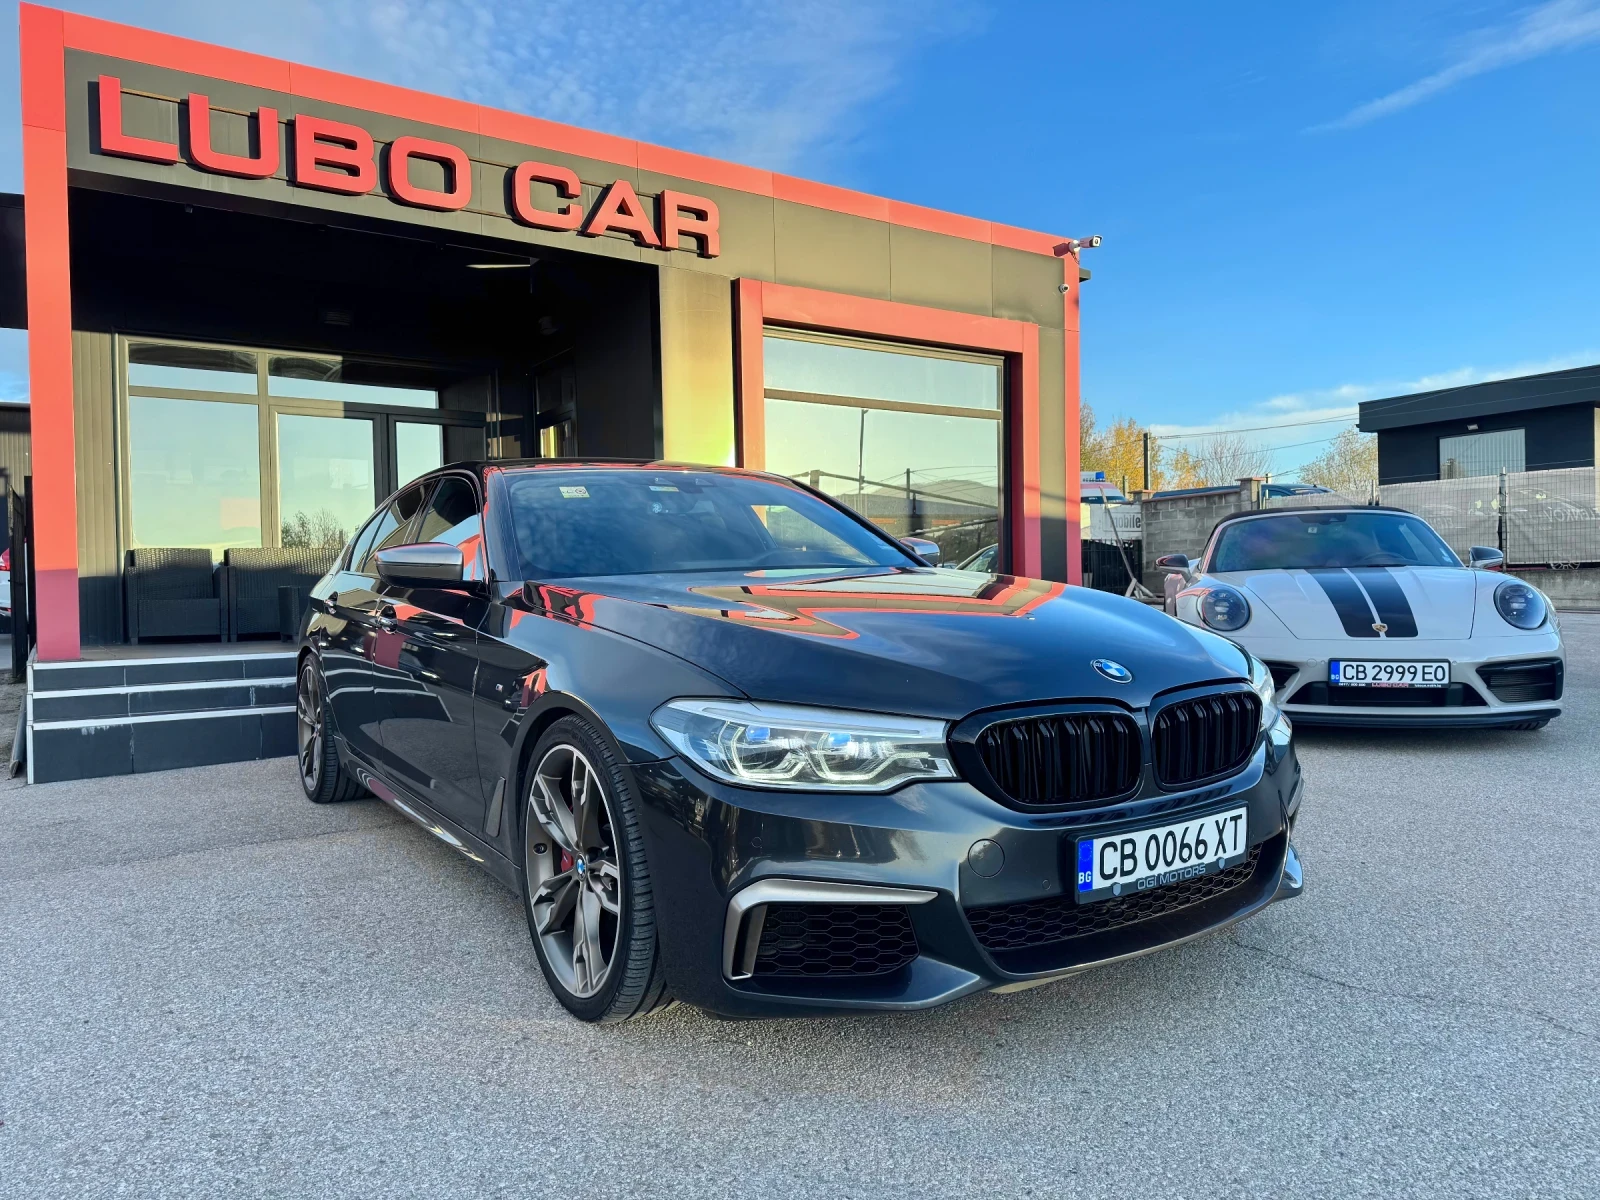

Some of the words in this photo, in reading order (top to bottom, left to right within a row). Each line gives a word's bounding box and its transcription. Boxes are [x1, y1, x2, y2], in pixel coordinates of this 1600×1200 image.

[96, 75, 471, 212] LUBO
[511, 161, 721, 258] CAR
[1343, 664, 1368, 681] CB
[1371, 665, 1418, 682] 2999
[1100, 838, 1138, 881] CB
[1145, 823, 1208, 871] 0066
[1214, 814, 1243, 856] XT
[1078, 871, 1092, 884] BG
[1137, 876, 1157, 890] OGI
[1159, 863, 1206, 885] MOTORS
